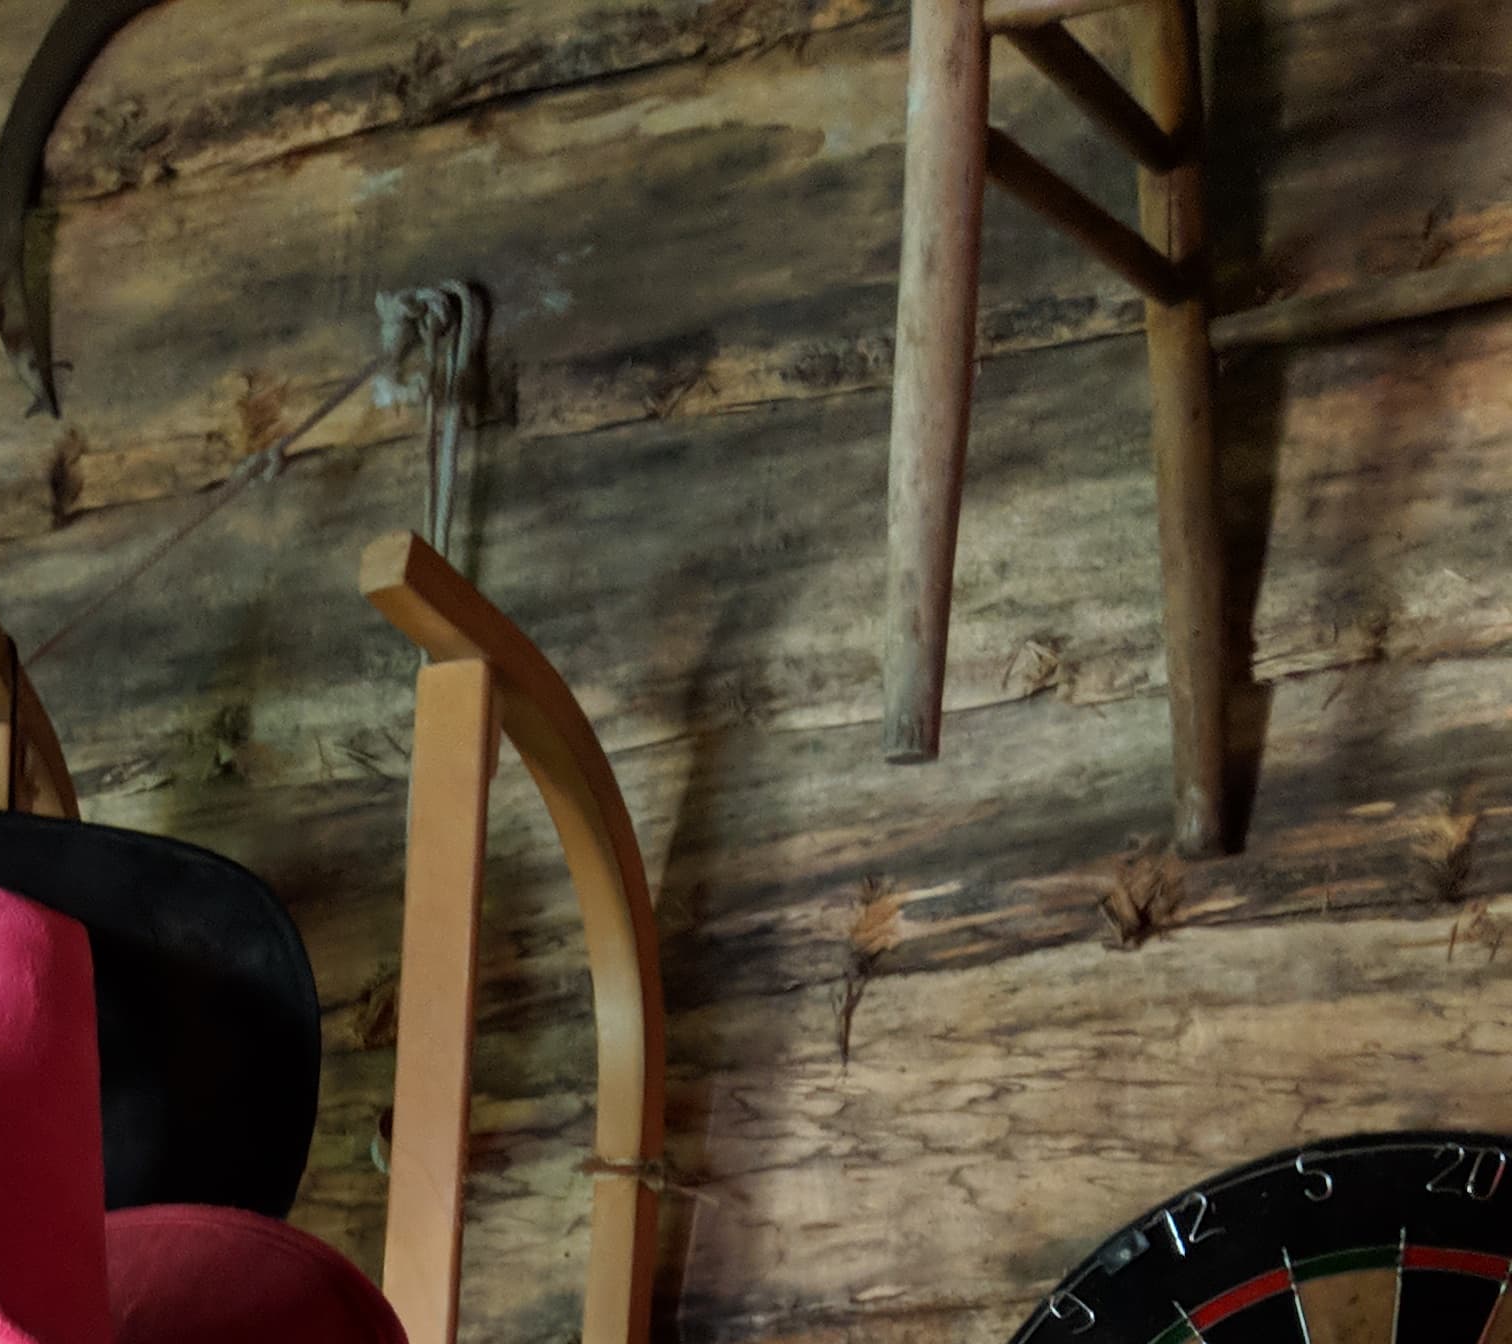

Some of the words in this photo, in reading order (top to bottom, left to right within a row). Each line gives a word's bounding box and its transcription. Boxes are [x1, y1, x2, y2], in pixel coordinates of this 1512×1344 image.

[1294, 1151, 1335, 1203] 5
[1424, 1140, 1507, 1202] 20
[1163, 1190, 1228, 1258] 12
